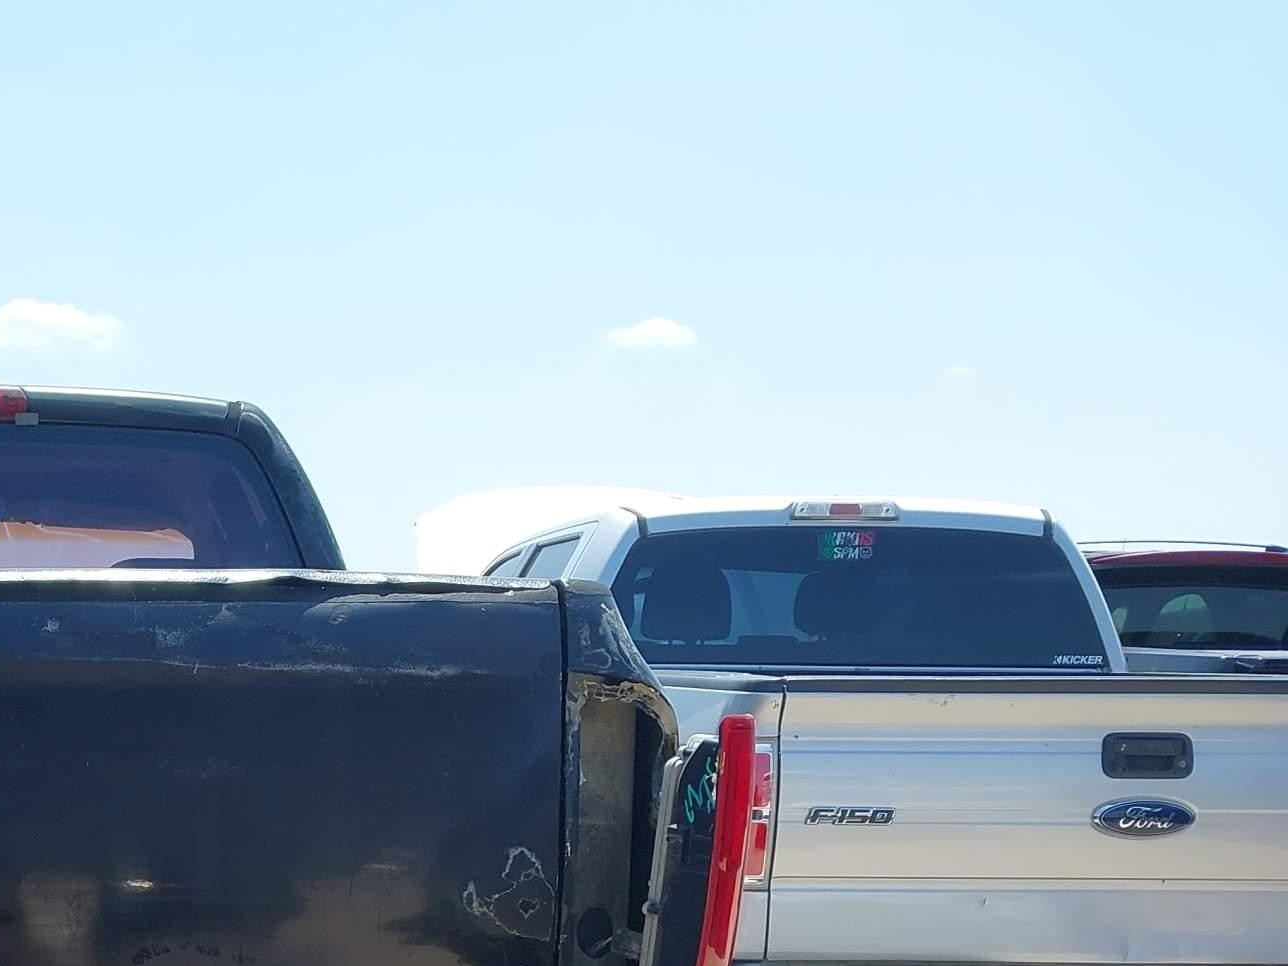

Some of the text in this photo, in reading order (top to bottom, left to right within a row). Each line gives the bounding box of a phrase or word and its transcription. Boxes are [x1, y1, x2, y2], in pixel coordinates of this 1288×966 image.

[1062, 655, 1104, 665] KICKER
[804, 806, 896, 826] F-150
[1119, 805, 1176, 829] Ford
